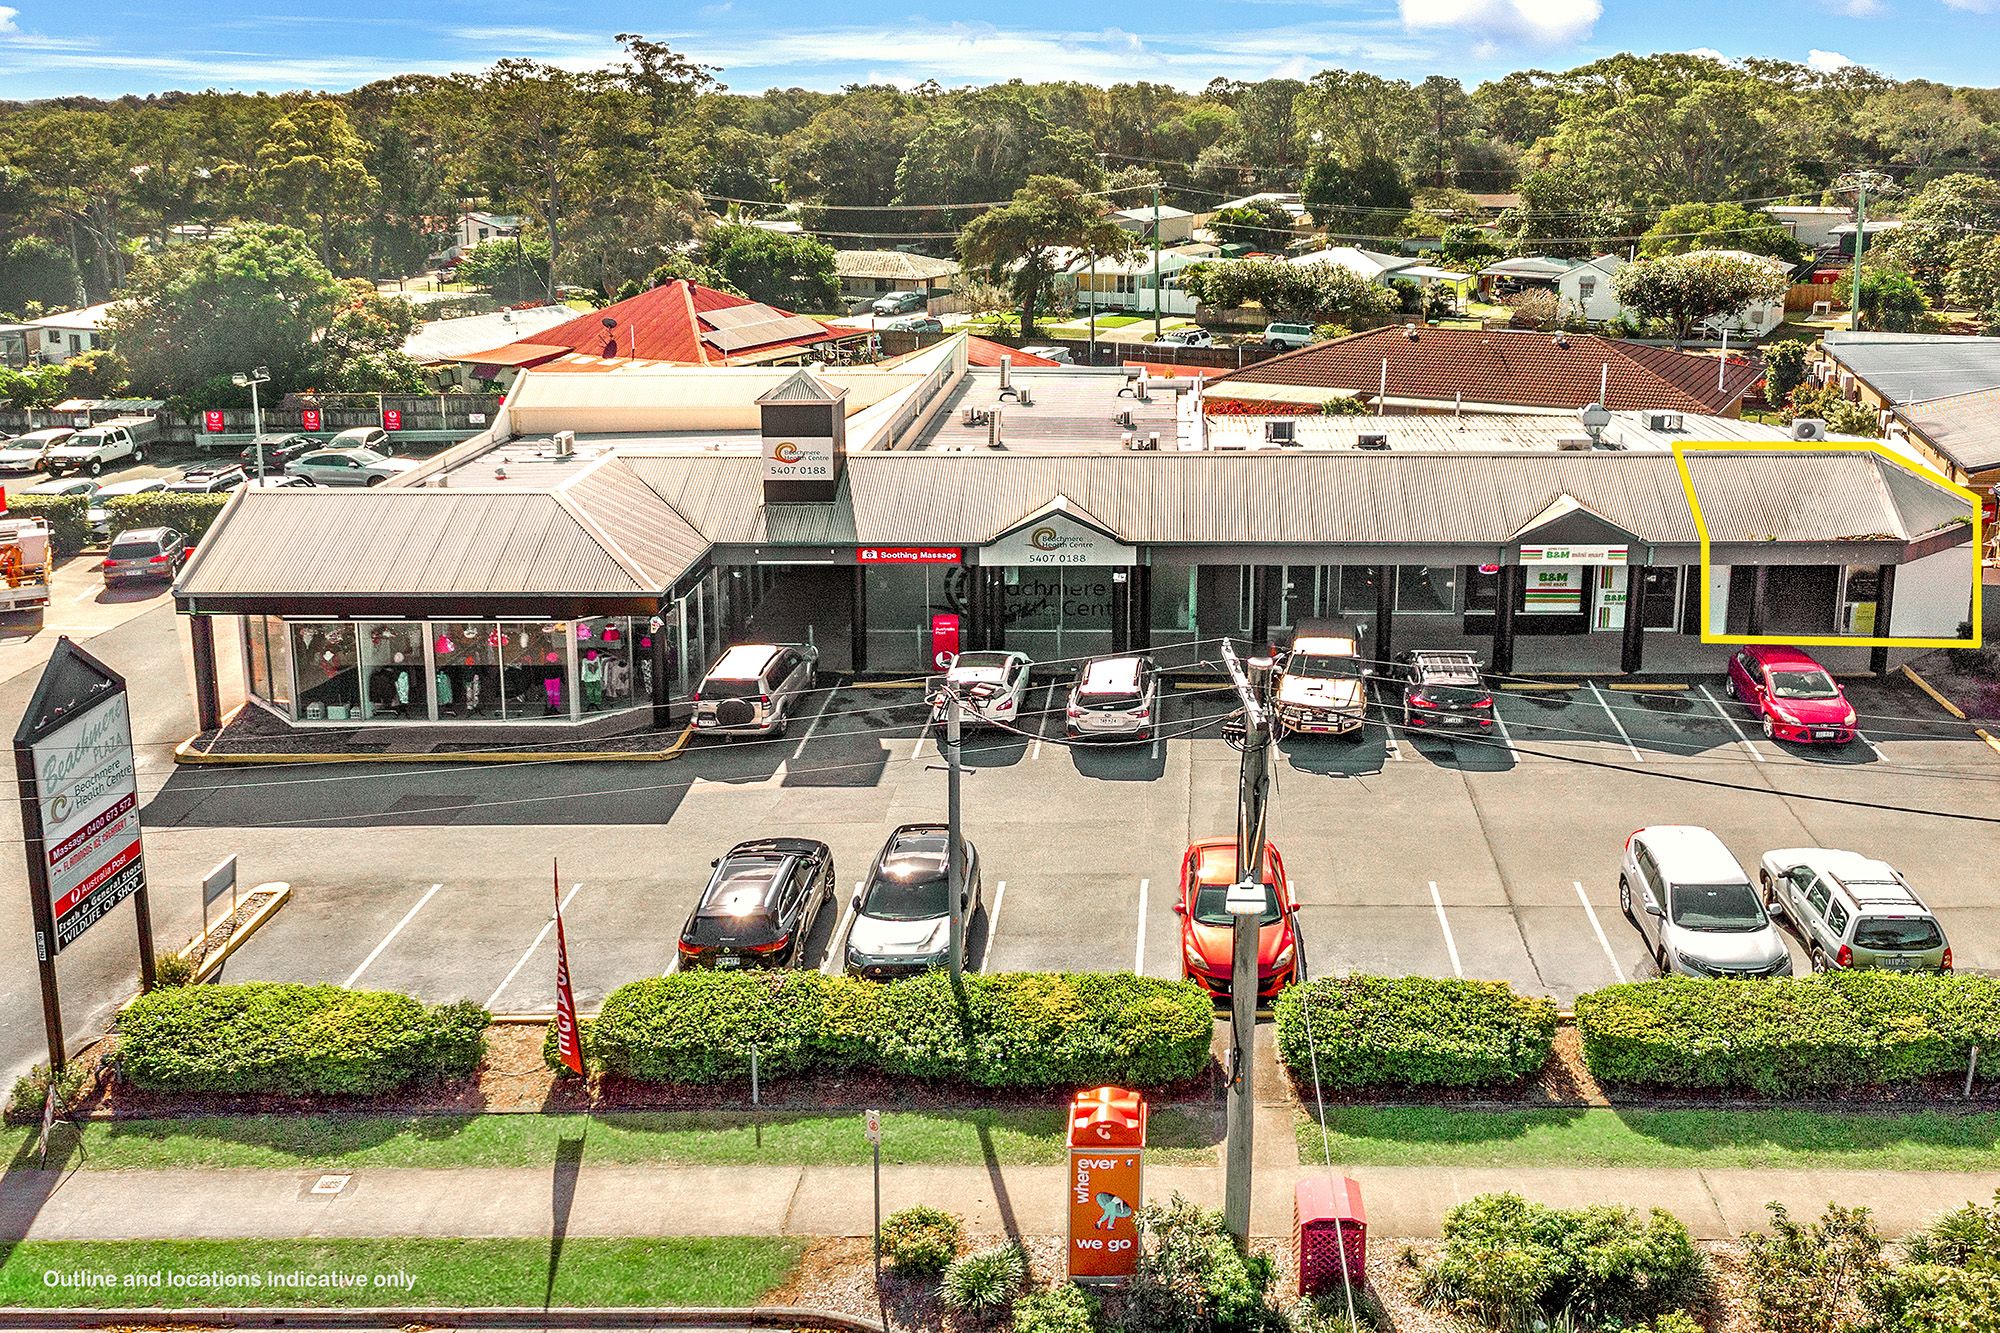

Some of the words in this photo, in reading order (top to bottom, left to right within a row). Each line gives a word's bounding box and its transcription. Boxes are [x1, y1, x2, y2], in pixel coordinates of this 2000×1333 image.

[771, 466, 796, 474] 5407
[800, 466, 826, 474] 0188
[880, 551, 918, 560] Soothing
[920, 551, 957, 560] Massage
[1029, 554, 1056, 562] 5407
[1059, 554, 1087, 562] 0188
[1539, 572, 1568, 581] B&M
[43, 699, 121, 794] Beachmere
[93, 732, 123, 763] PLAZA
[75, 760, 120, 796] Beachmere
[76, 781, 104, 809] Health
[107, 765, 132, 787] Centre
[53, 833, 86, 860] Massage
[87, 817, 105, 835] 0400
[106, 807, 119, 821] 673
[120, 797, 132, 812] 572
[81, 866, 112, 894] Australia
[112, 854, 127, 870] Post
[58, 910, 80, 933] Fresh
[82, 903, 90, 914] &
[91, 877, 120, 906] General
[122, 862, 142, 882] Store
[63, 907, 101, 943] WILDLIFE
[103, 895, 116, 911] OP
[118, 877, 139, 900] SHOP
[1076, 1239, 1103, 1249] we
[1107, 1238, 1132, 1252] go
